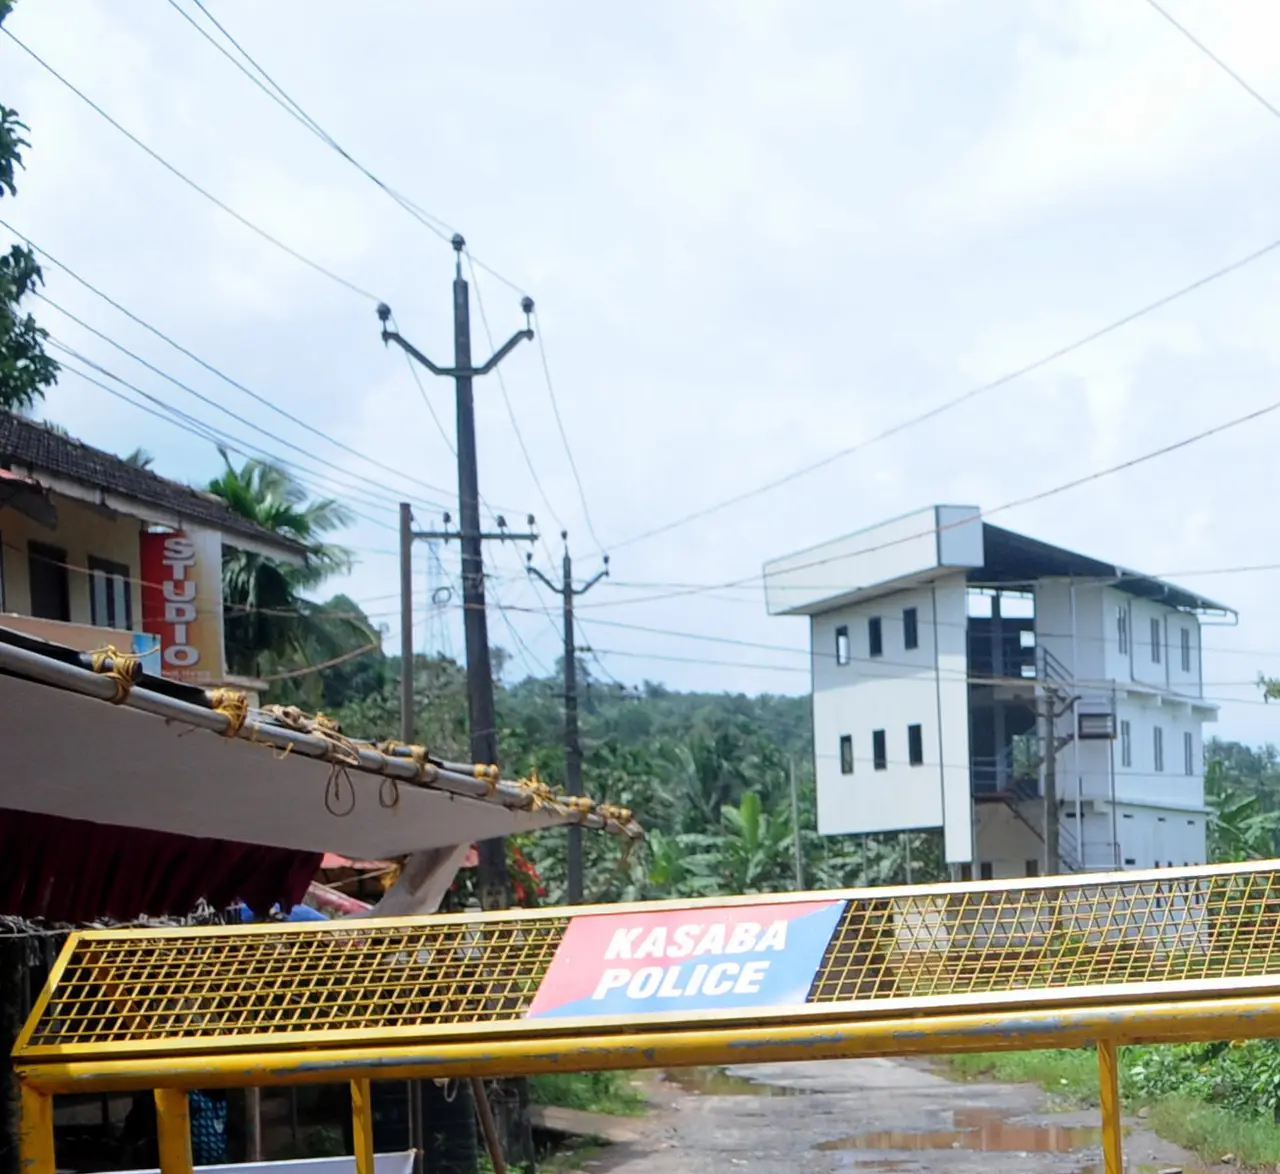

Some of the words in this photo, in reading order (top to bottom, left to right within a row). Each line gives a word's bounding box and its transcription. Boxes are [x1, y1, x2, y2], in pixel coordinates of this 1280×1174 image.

[162, 537, 199, 667] STUDIO
[605, 920, 786, 960] KASABA
[593, 961, 769, 999] POLICE
